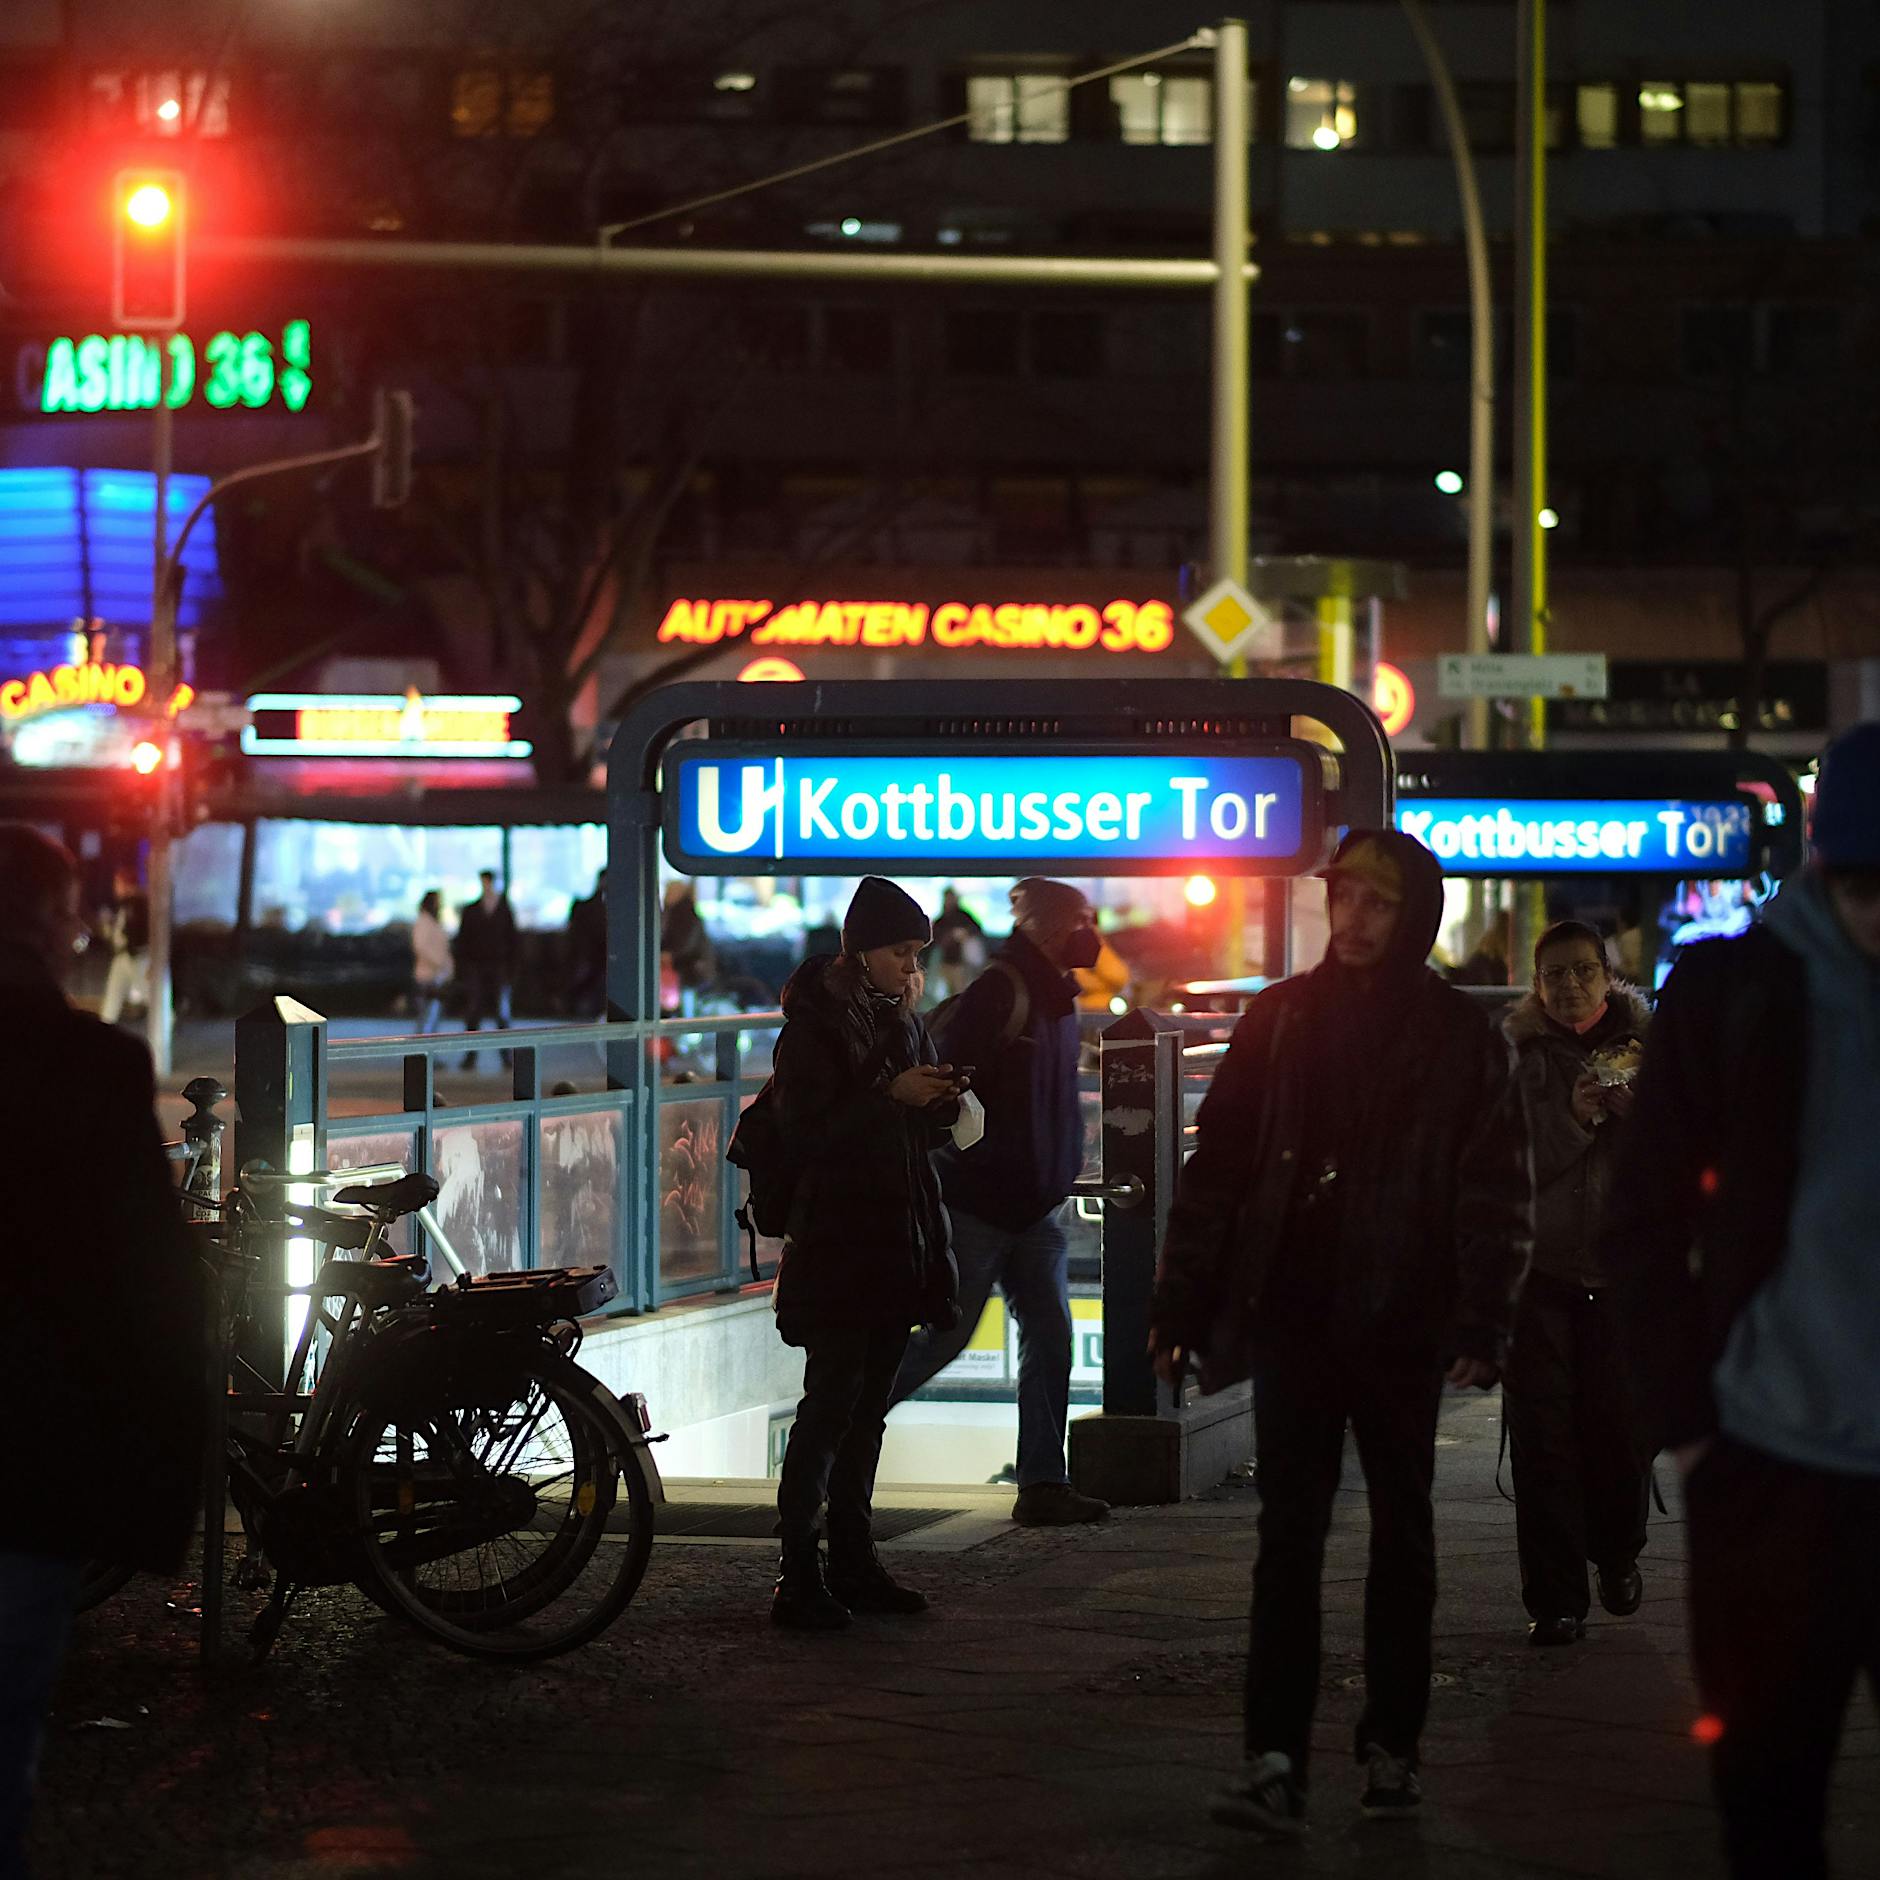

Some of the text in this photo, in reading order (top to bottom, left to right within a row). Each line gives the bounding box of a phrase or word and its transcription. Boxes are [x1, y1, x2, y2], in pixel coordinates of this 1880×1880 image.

[931, 602, 1102, 648] CASINO
[1101, 600, 1175, 652] 36
[0, 663, 146, 720] CASINO
[800, 773, 1152, 841] Kottbusser
[1169, 776, 1276, 841] Tor
[1401, 808, 1735, 859] Kottbusser Tor
